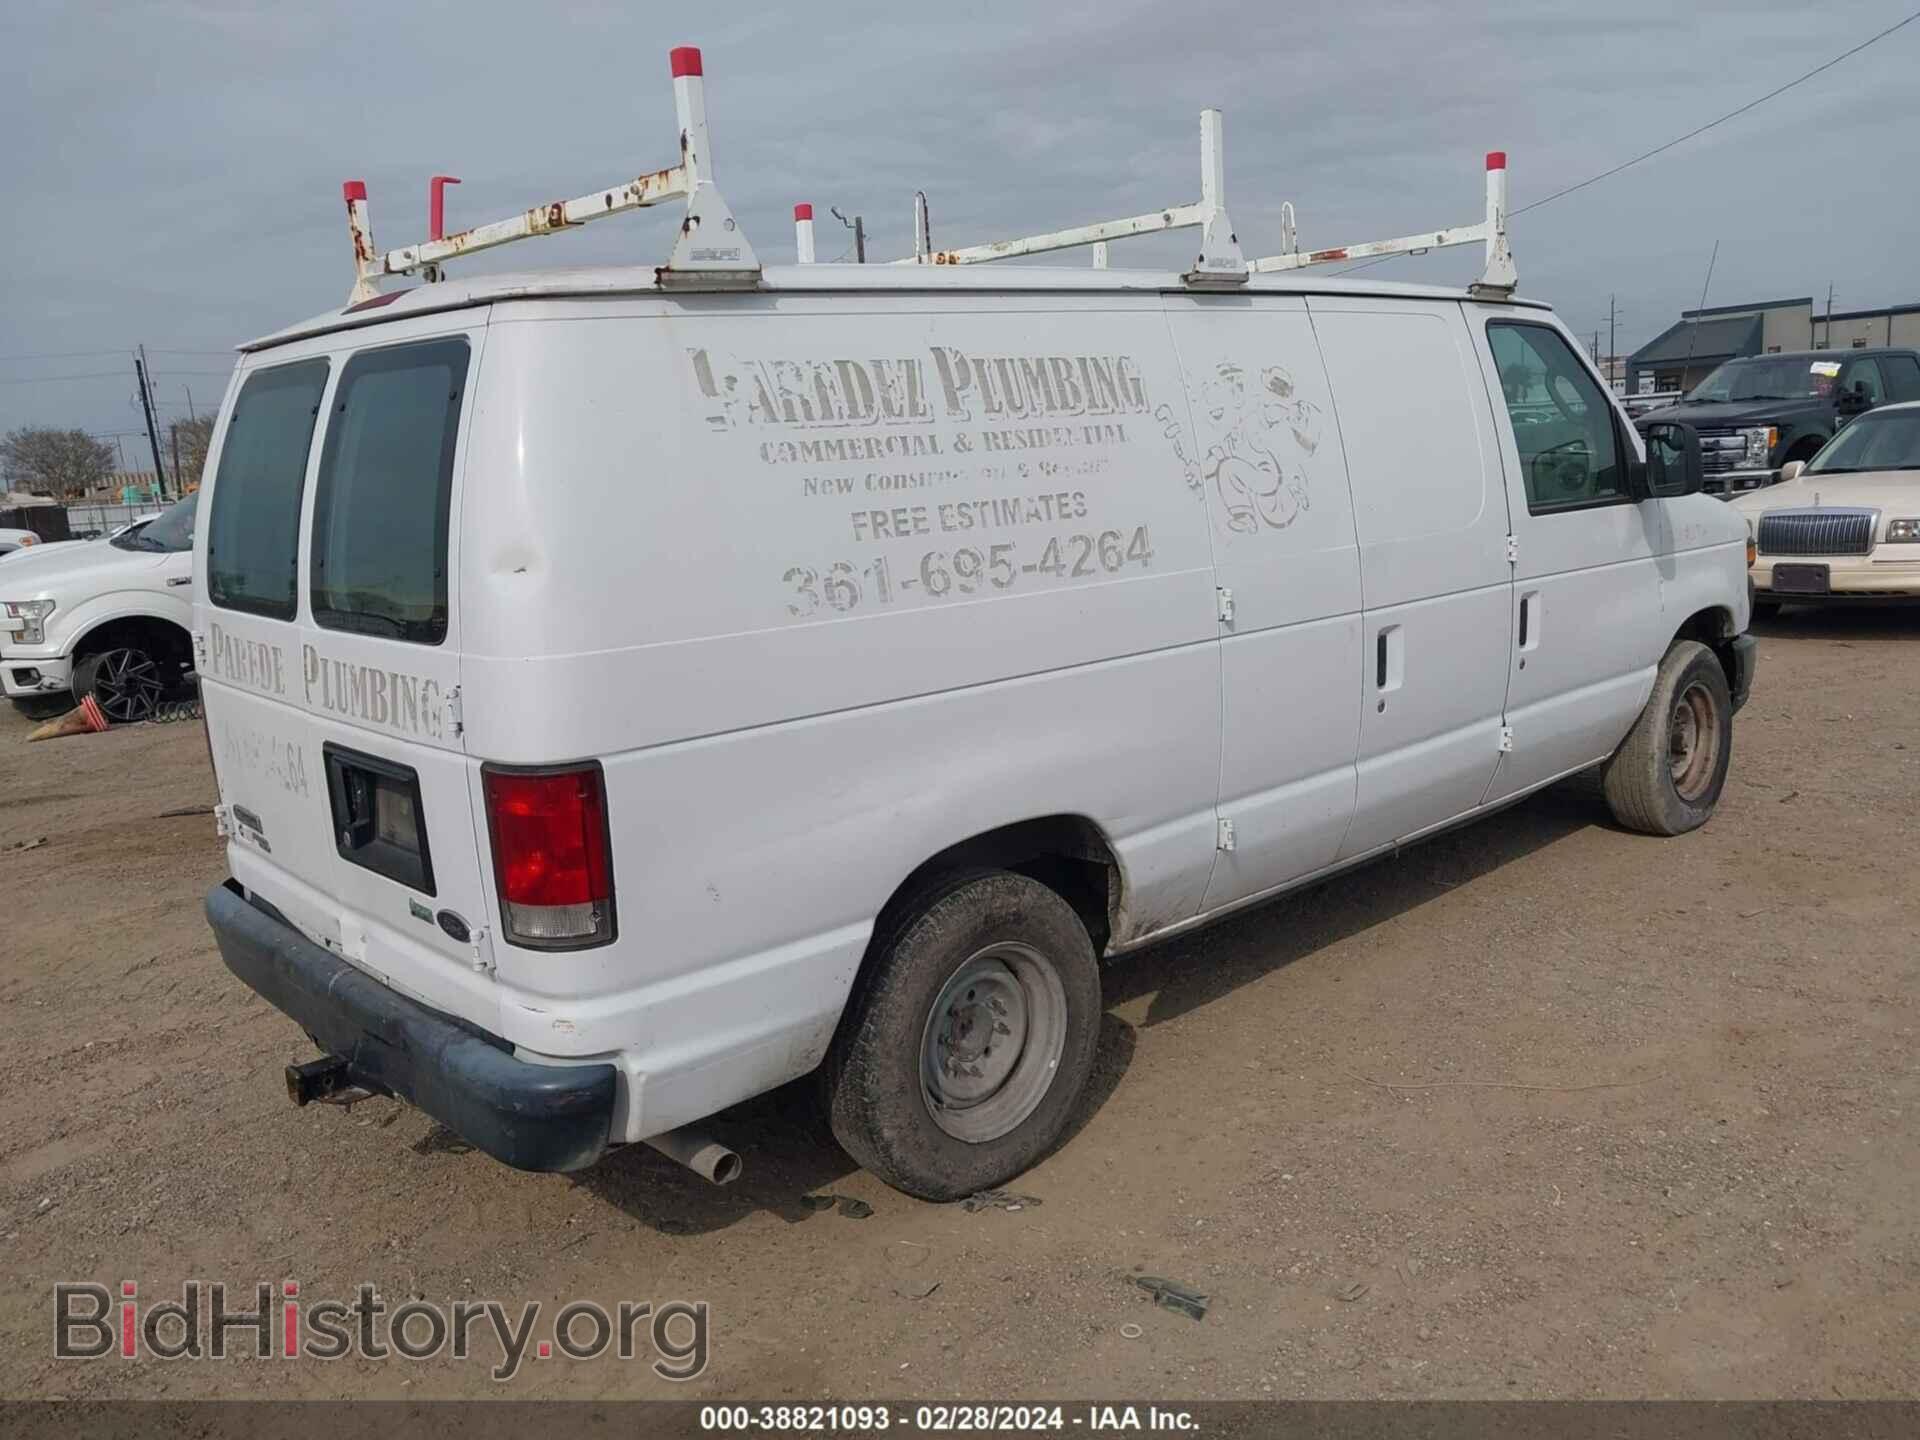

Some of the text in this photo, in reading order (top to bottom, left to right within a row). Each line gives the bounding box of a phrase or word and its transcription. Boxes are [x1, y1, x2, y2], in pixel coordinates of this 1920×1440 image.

[930, 346, 1151, 423] PLUMBING
[760, 434, 943, 465] COMMERCIAL
[953, 432, 974, 454] &
[850, 491, 1088, 542] FREE ESTIMATES
[782, 523, 1155, 618] 361-695-4264
[303, 643, 444, 741] PLUMBING
